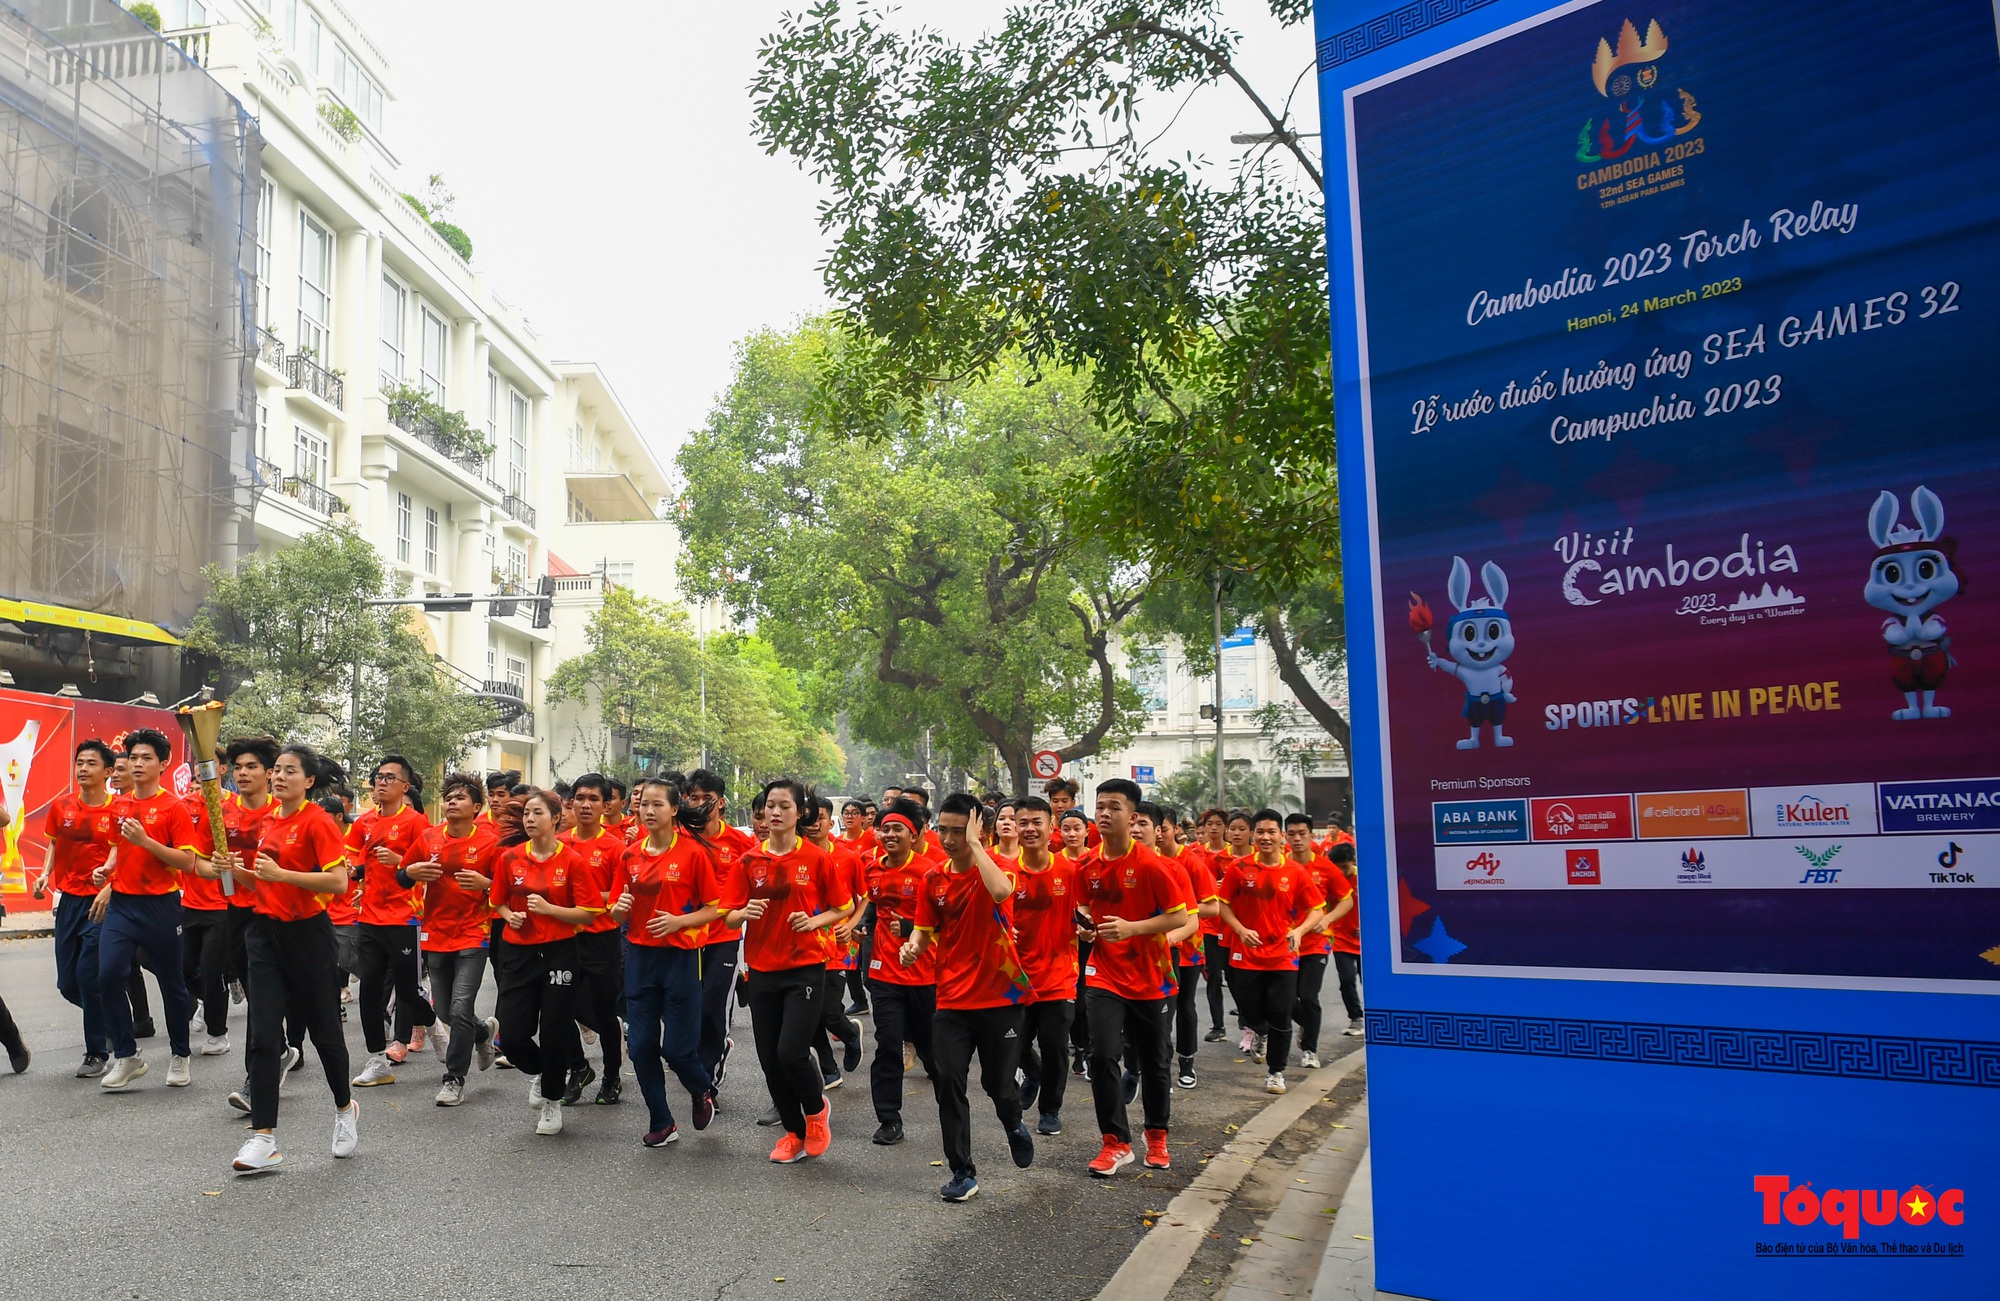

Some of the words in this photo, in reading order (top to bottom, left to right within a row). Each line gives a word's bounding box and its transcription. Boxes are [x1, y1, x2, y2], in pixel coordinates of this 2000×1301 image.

[1577, 151, 1661, 190] CAMBODIA
[1664, 137, 1705, 164] 2023
[1599, 183, 1624, 199] 32nd
[1626, 176, 1645, 191] SEA
[1647, 164, 1684, 184] GAMES
[1600, 196, 1616, 209] 12th
[1617, 192, 1639, 204] ASEAN
[1640, 186, 1659, 197] PARA
[1660, 178, 1686, 192] GAMES
[1466, 267, 1597, 326] Cambodia
[1602, 242, 1673, 287] 2023
[1679, 218, 1762, 269] Torch
[1769, 199, 1858, 243] Relay
[1567, 309, 1616, 332] Hanoi,
[1620, 300, 1639, 319] 24
[1644, 288, 1698, 314] March
[1701, 276, 1743, 299] 2023
[1411, 394, 1439, 434] Lễ
[1443, 389, 1495, 422] rước
[1499, 370, 1558, 410] đuốc
[1561, 360, 1637, 397] hưởng
[1644, 347, 1693, 379] ứng
[1703, 323, 1767, 365] SEA
[1778, 291, 1909, 348] GAMES
[1919, 281, 1961, 319] 32
[1550, 393, 1696, 445] Campuchia
[1703, 375, 1783, 416] 2023
[1553, 526, 1634, 564] Visit
[1562, 532, 1800, 606] Cambodia
[1681, 593, 1717, 611] 2023
[1700, 615, 1727, 628] Every
[1729, 613, 1747, 625] day
[1748, 612, 1756, 620] is
[1764, 607, 1805, 618] Wonder
[1545, 697, 1640, 731] SPORTS
[1647, 692, 1704, 724] LIVE
[1712, 689, 1742, 719] IN
[1749, 681, 1842, 716] PEACE
[1430, 779, 1477, 791] Premium
[1479, 776, 1531, 791] Sponsors
[1442, 811, 1471, 824] ABA
[1477, 809, 1518, 822] BANK
[1655, 805, 1700, 818] cellcard
[1776, 804, 1785, 822] eau
[1786, 802, 1850, 822] Kulen
[1917, 812, 1976, 822] BREWERY
[1549, 824, 1573, 835] AIA
[1799, 869, 1842, 884] FBT
[1929, 872, 1975, 884] TikTok
